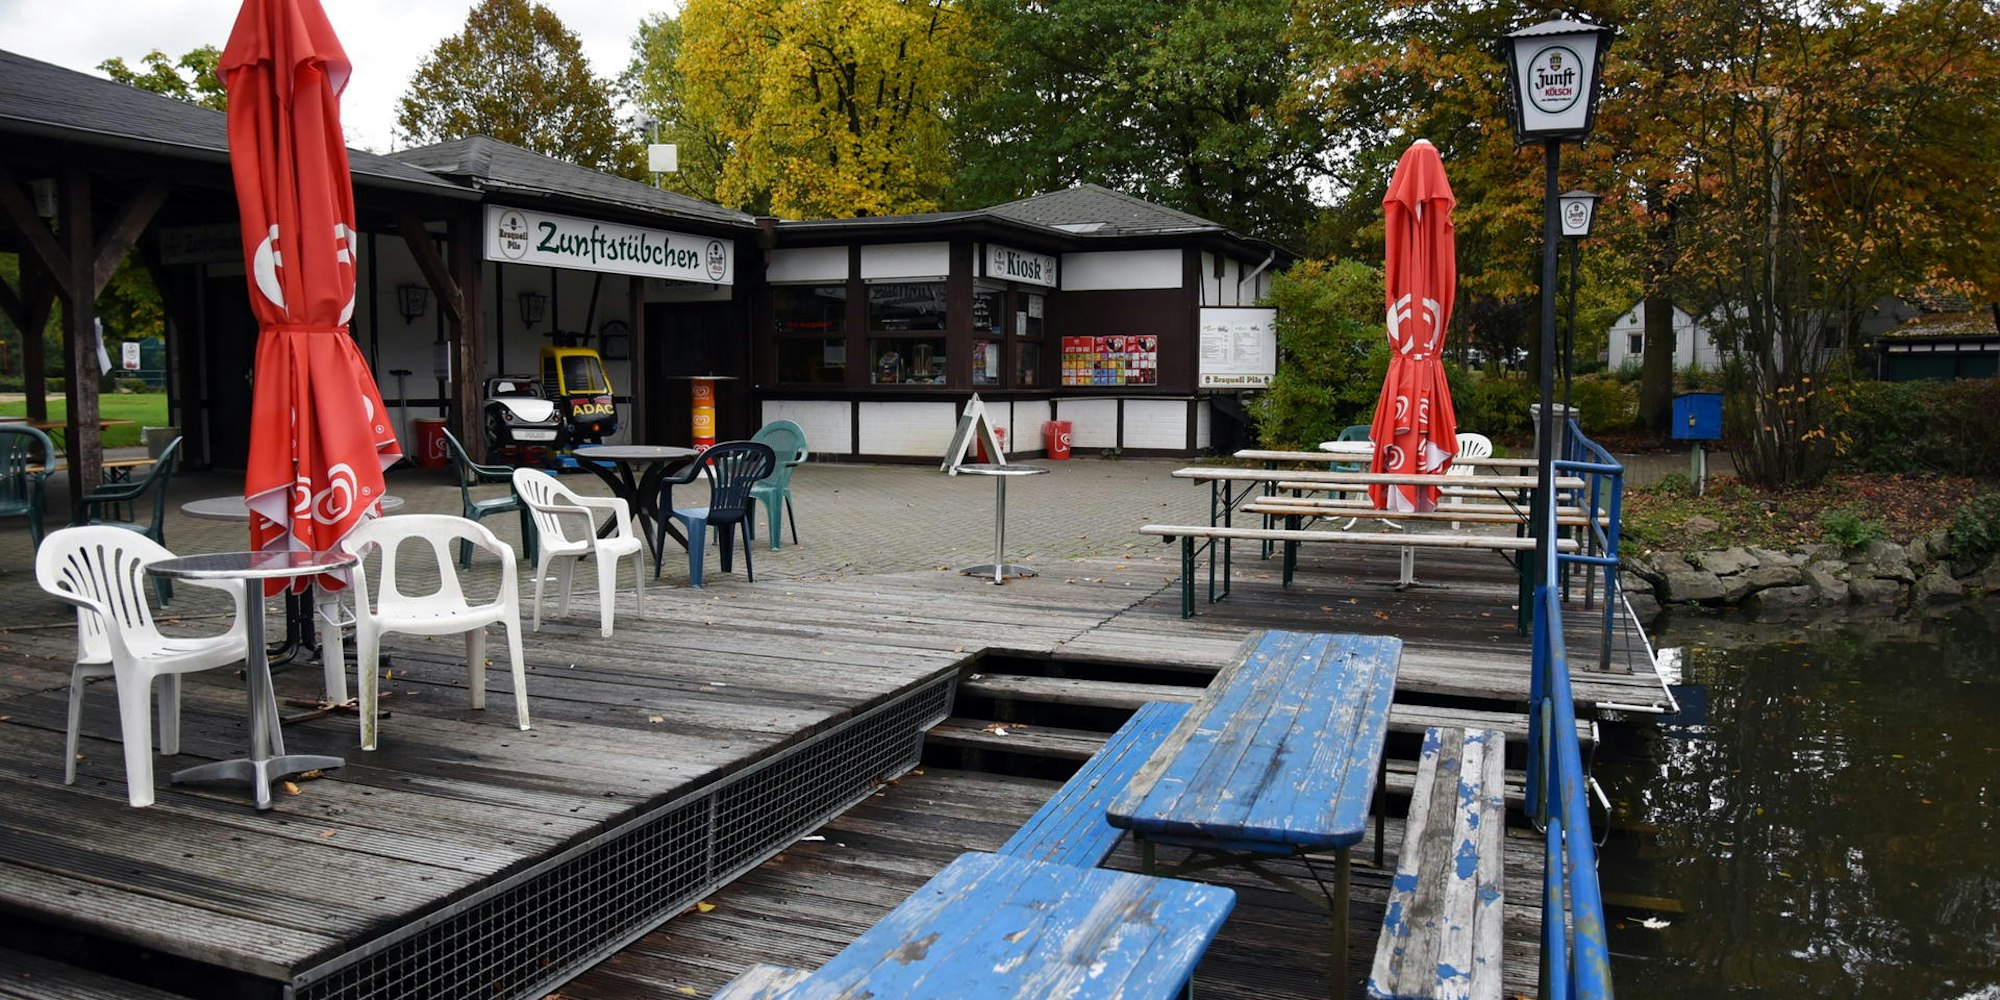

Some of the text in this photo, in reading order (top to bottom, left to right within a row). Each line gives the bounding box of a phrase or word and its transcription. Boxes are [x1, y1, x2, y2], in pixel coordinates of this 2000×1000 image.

[1535, 67, 1576, 90] Zunft
[1545, 87, 1572, 97] KÖLSCH
[536, 221, 700, 270] Zunftstübchen
[1007, 250, 1041, 280] Kiosk
[573, 403, 615, 417] ADAC
